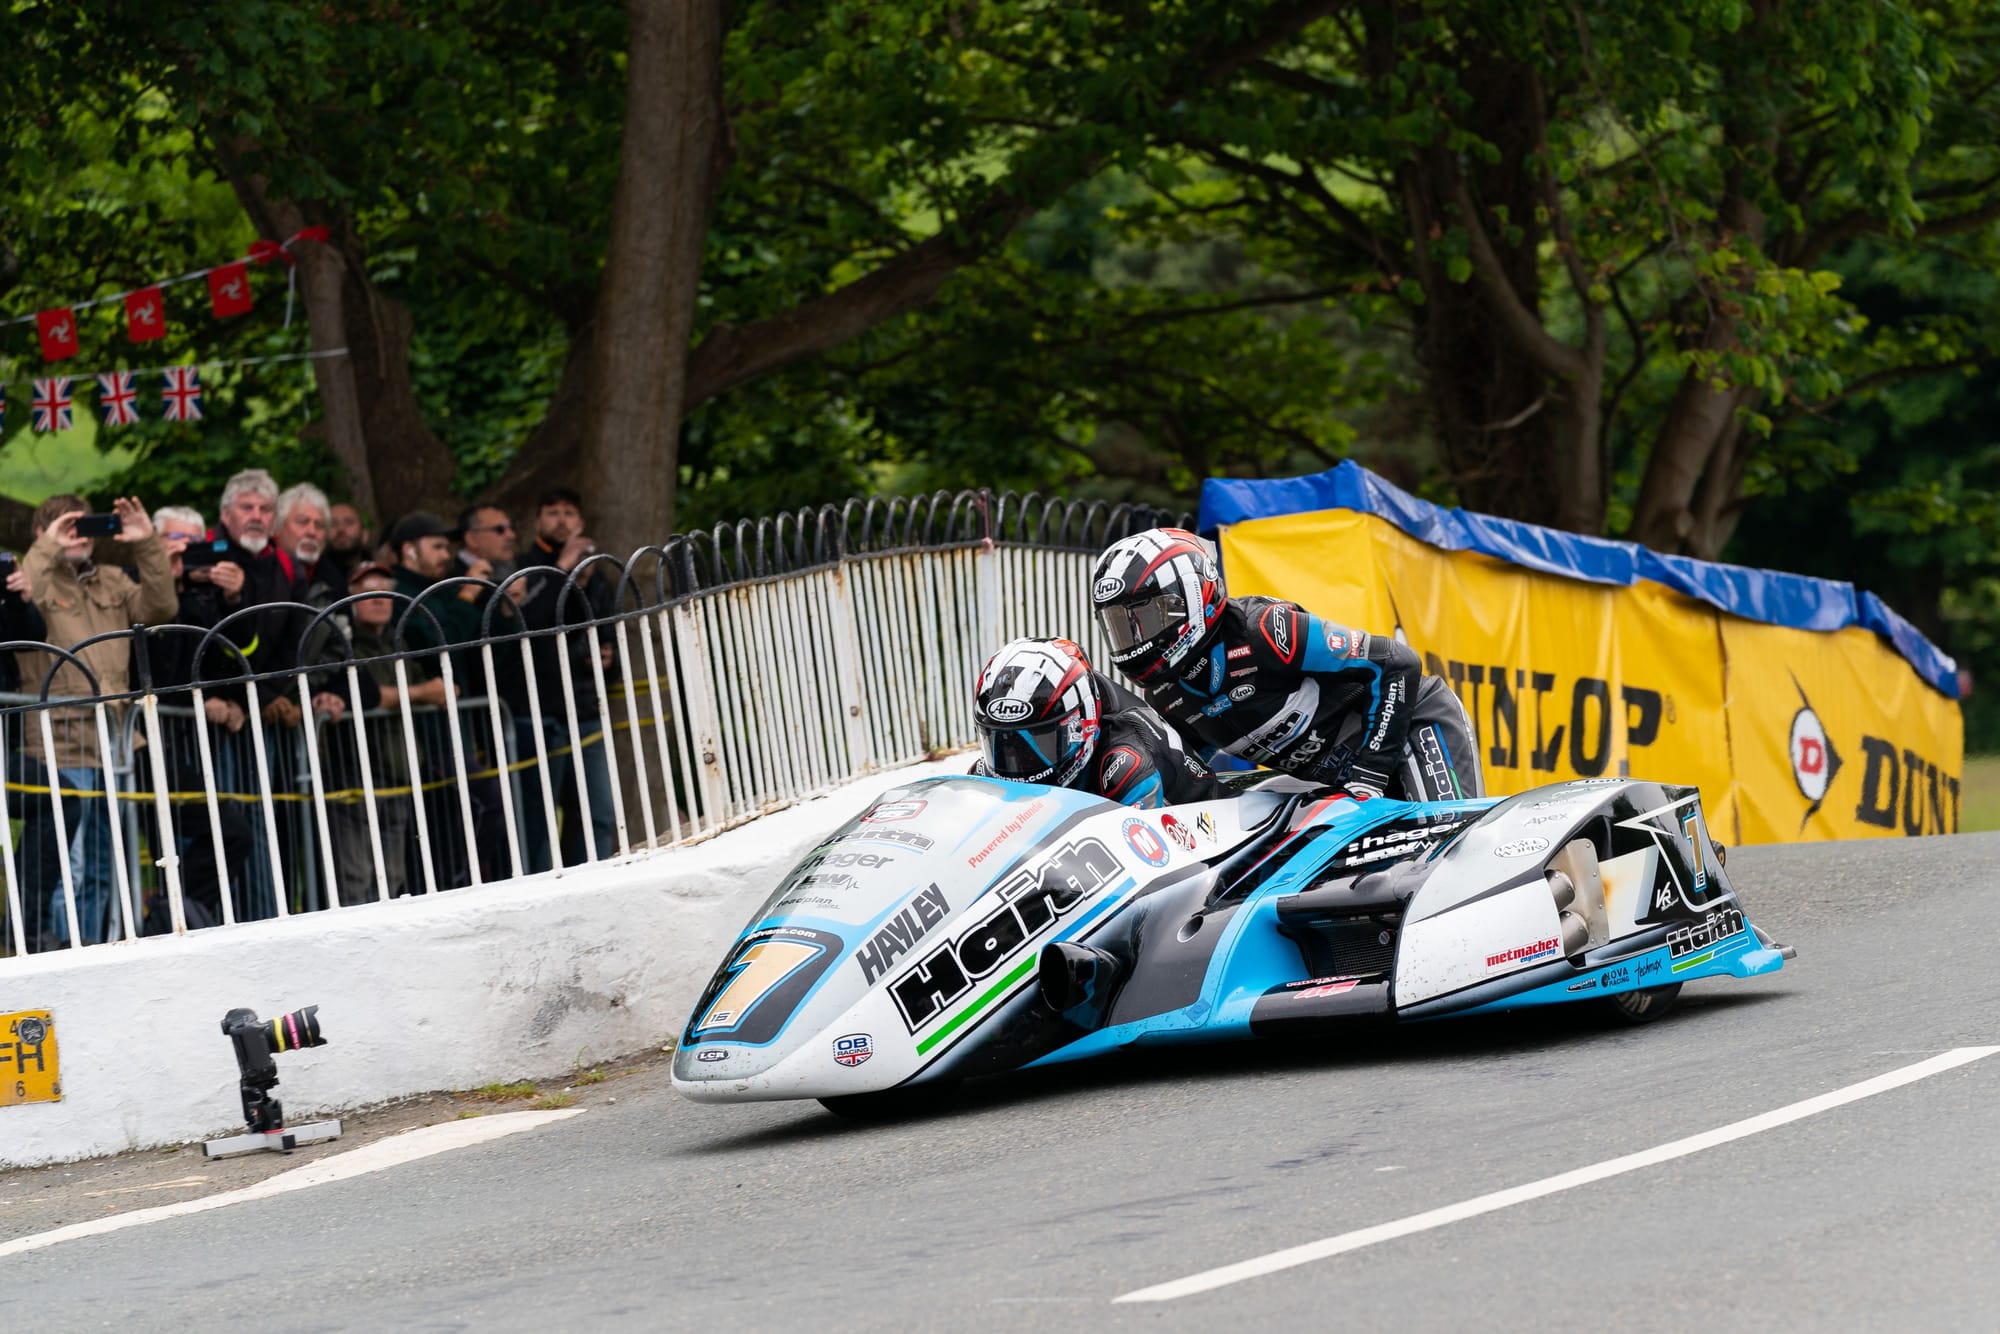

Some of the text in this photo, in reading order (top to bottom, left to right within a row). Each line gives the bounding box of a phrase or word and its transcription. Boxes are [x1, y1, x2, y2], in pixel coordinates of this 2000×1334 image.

[1273, 605, 1290, 655] RST
[1228, 647, 1251, 659] MOTUL
[990, 701, 1026, 714] Arai
[1233, 686, 1252, 698] Arai
[1370, 682, 1398, 751] Steadplan
[1241, 709, 1304, 761] aith
[1102, 751, 1129, 790] RST
[1799, 736, 1824, 775] D
[968, 828, 1008, 868] Powered
[1005, 821, 1022, 832] by
[855, 882, 951, 987] HAYLEY
[886, 837, 1126, 1037] Haith
[1667, 909, 1746, 959] Haith
[1486, 937, 1559, 967] metmachex
[1520, 948, 1556, 963] engineering
[699, 1050, 725, 1059] LCR
[837, 1037, 868, 1050] OB
[837, 1047, 869, 1056] RACING
[15, 1080, 26, 1097] 6
